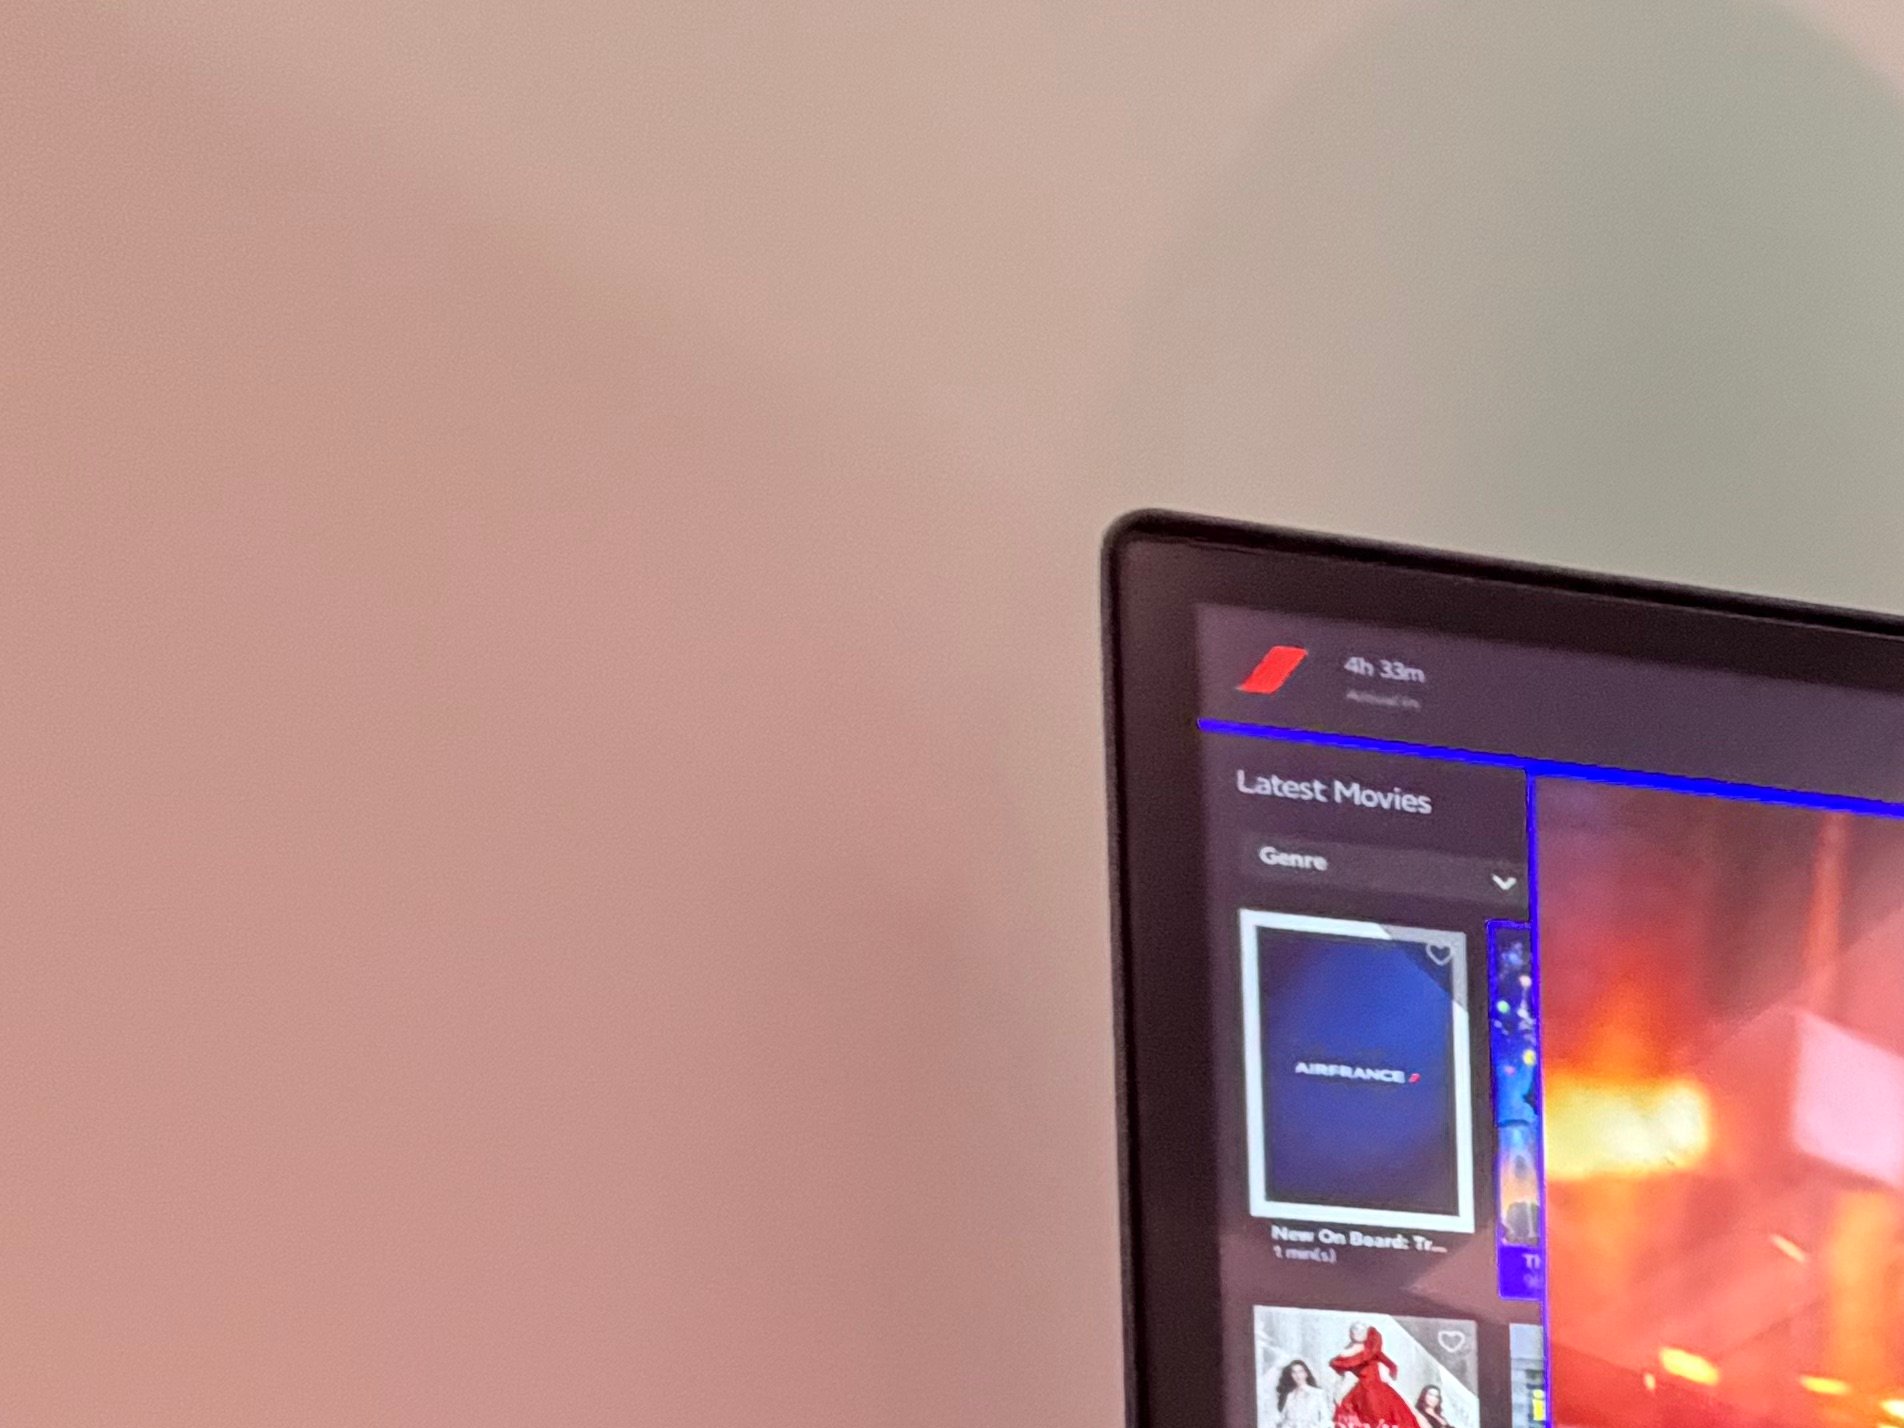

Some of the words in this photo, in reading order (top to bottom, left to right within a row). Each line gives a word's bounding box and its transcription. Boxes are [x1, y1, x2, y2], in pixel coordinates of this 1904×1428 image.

[1344, 656, 1374, 677] 4h
[1379, 659, 1425, 683] 33m
[1236, 769, 1328, 802] Latest
[1333, 780, 1432, 814] Movies
[1259, 846, 1328, 871] Genre
[1271, 1224, 1315, 1243] New
[1318, 1228, 1347, 1245] On
[1350, 1230, 1409, 1250] Board:
[1285, 1248, 1337, 1264] min(s)
